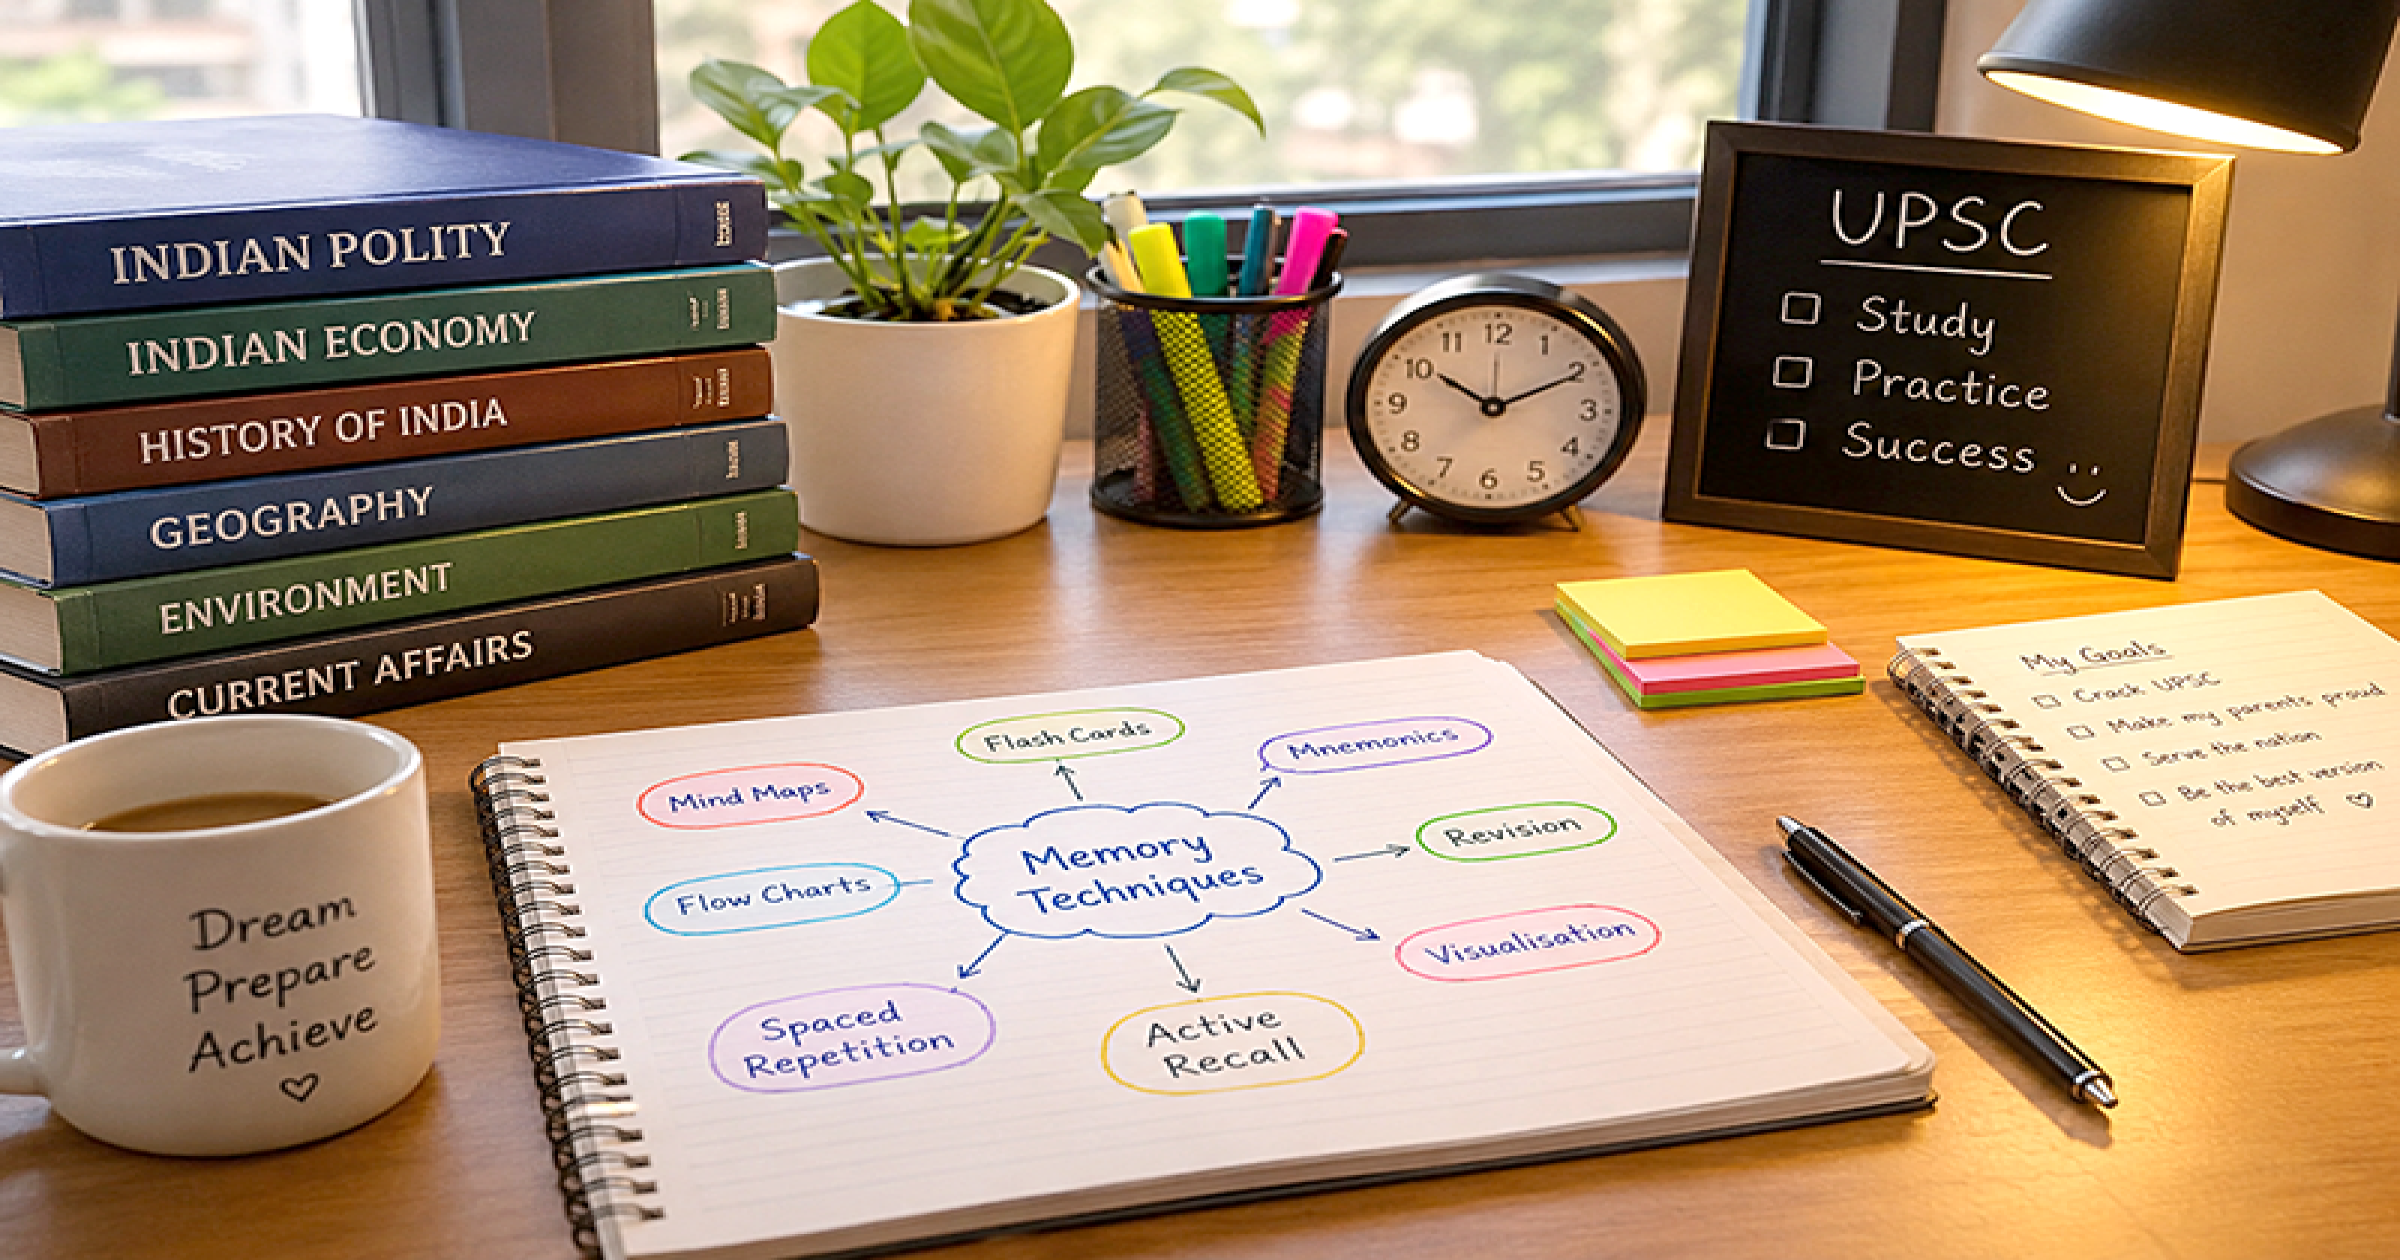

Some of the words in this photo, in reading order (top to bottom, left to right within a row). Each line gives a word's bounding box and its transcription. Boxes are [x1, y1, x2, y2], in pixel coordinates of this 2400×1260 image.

[1831, 187, 2050, 257] UPSC
[110, 235, 311, 285] INDIAN
[328, 221, 512, 269] POLITY
[126, 327, 308, 375] INDIAN
[324, 310, 537, 361] ECONOMY
[1442, 332, 1462, 353] 11
[1484, 323, 1513, 345] 12
[1541, 335, 1549, 355] 1
[1855, 294, 1996, 357] Study
[1406, 358, 1434, 379] 10
[1568, 361, 1586, 383] 2
[1852, 357, 2051, 411] Practice
[1388, 392, 1408, 414] 9
[1578, 399, 1597, 421] 3
[139, 413, 324, 465] HISTORY
[334, 407, 386, 442] OF
[399, 396, 509, 436] INDIA
[1400, 430, 1420, 452] 8
[1560, 437, 1579, 457] 4
[1841, 420, 2036, 474] Success
[1437, 456, 1453, 478] 7
[1479, 468, 1498, 490] 6
[1527, 460, 1546, 482] 5
[150, 485, 435, 551] GEOGRAPHY
[158, 562, 454, 635] ENVIRONMENT
[167, 660, 363, 720] CURRENT
[373, 629, 536, 685] AFFAIRS
[2018, 652, 2078, 675] My
[2078, 640, 2167, 664] Goals
[2072, 682, 2146, 703] Crack
[2151, 671, 2221, 692] UPSC
[2106, 714, 2173, 734] Make
[2180, 711, 2223, 727] my
[2226, 694, 2314, 721] parents
[2321, 682, 2386, 707] proud
[983, 729, 1065, 753] Flash
[1068, 719, 1152, 743] Cards
[1286, 725, 1460, 760] Mnemonics
[2141, 747, 2209, 768] Serve
[2210, 740, 2249, 756] the
[2254, 729, 2322, 749] nation
[668, 786, 744, 813] Mind
[752, 779, 832, 805] Maps
[2177, 785, 2212, 801] Be
[2213, 778, 2254, 794] the
[2253, 770, 2305, 789] best
[2308, 760, 2385, 780] version
[1443, 815, 1582, 847] Revision
[2210, 807, 2238, 828] of
[2246, 794, 2326, 826] myself
[1020, 832, 1213, 876] Memory
[676, 893, 752, 916] Flow
[761, 876, 872, 904] Charts
[1015, 862, 1265, 915] Techniques
[188, 897, 358, 951] Dream
[1423, 920, 1636, 966] Visualisation
[183, 946, 377, 1014] Prepare
[189, 1006, 379, 1073] Achieve
[759, 999, 903, 1047] Spaced
[1145, 1008, 1282, 1048] Active
[743, 1030, 956, 1080] Repetition
[1163, 1035, 1306, 1079] Recall
